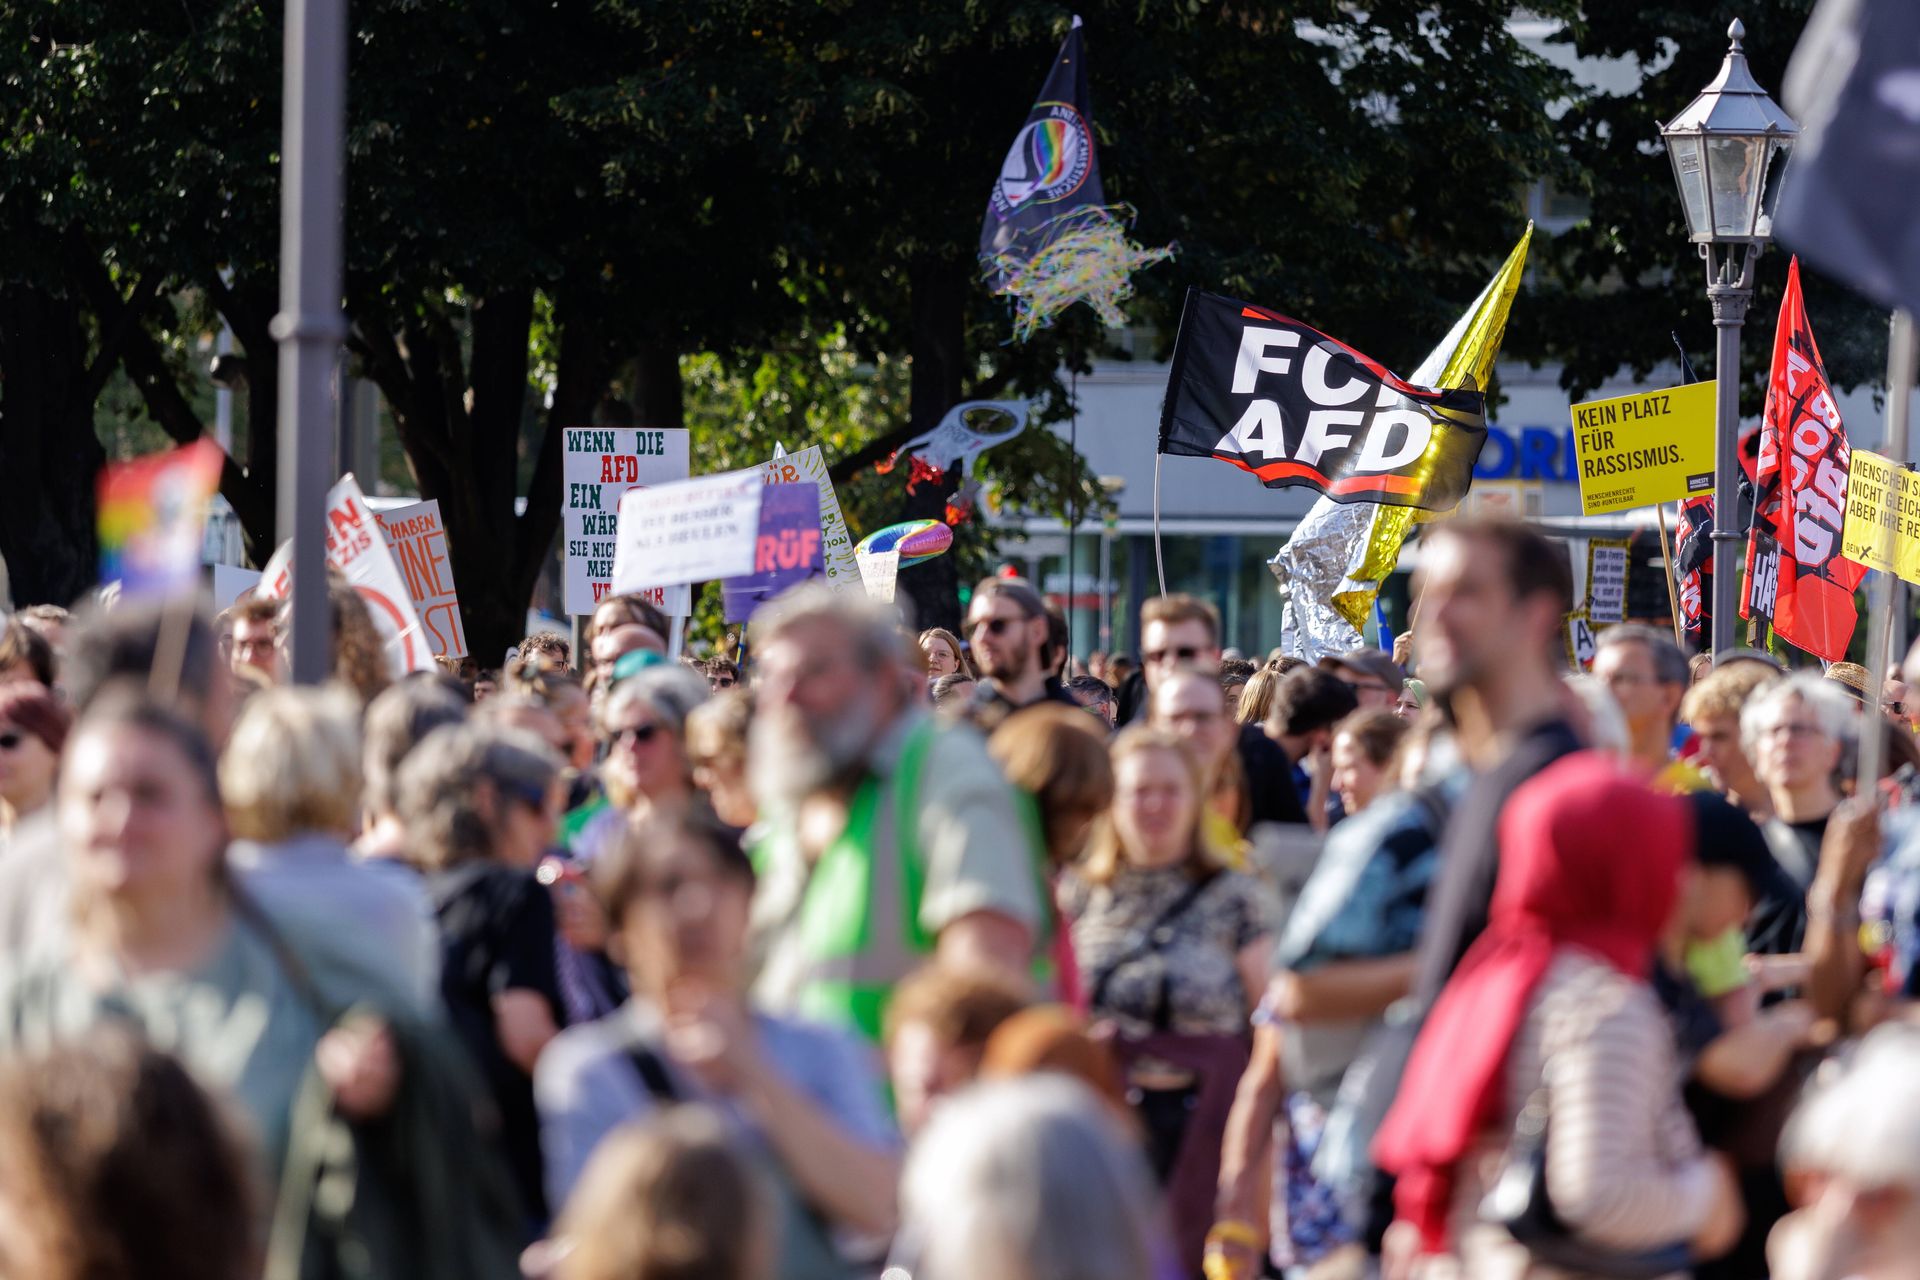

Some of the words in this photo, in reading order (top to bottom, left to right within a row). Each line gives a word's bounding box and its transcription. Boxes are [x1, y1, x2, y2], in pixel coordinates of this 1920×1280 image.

[1578, 404, 1617, 429] KEIN
[1622, 395, 1671, 422] PLATZ
[567, 430, 616, 453] WENN
[636, 431, 664, 455] DIE
[1214, 398, 1433, 472] AFD
[1581, 429, 1615, 454] FÜR
[600, 455, 639, 483] AFD
[1584, 444, 1684, 478] RASSISMUS.
[1851, 479, 1884, 505] NICHT
[1853, 458, 1910, 494] MENSCHEN
[1912, 480, 1920, 498] S
[569, 483, 602, 509] EIN
[391, 512, 436, 540] HABEN
[1849, 500, 1877, 524] ABER
[1879, 510, 1904, 534] IHRE
[569, 540, 588, 557] SIE
[1845, 541, 1860, 556] DEIN
[398, 530, 457, 602] INE
